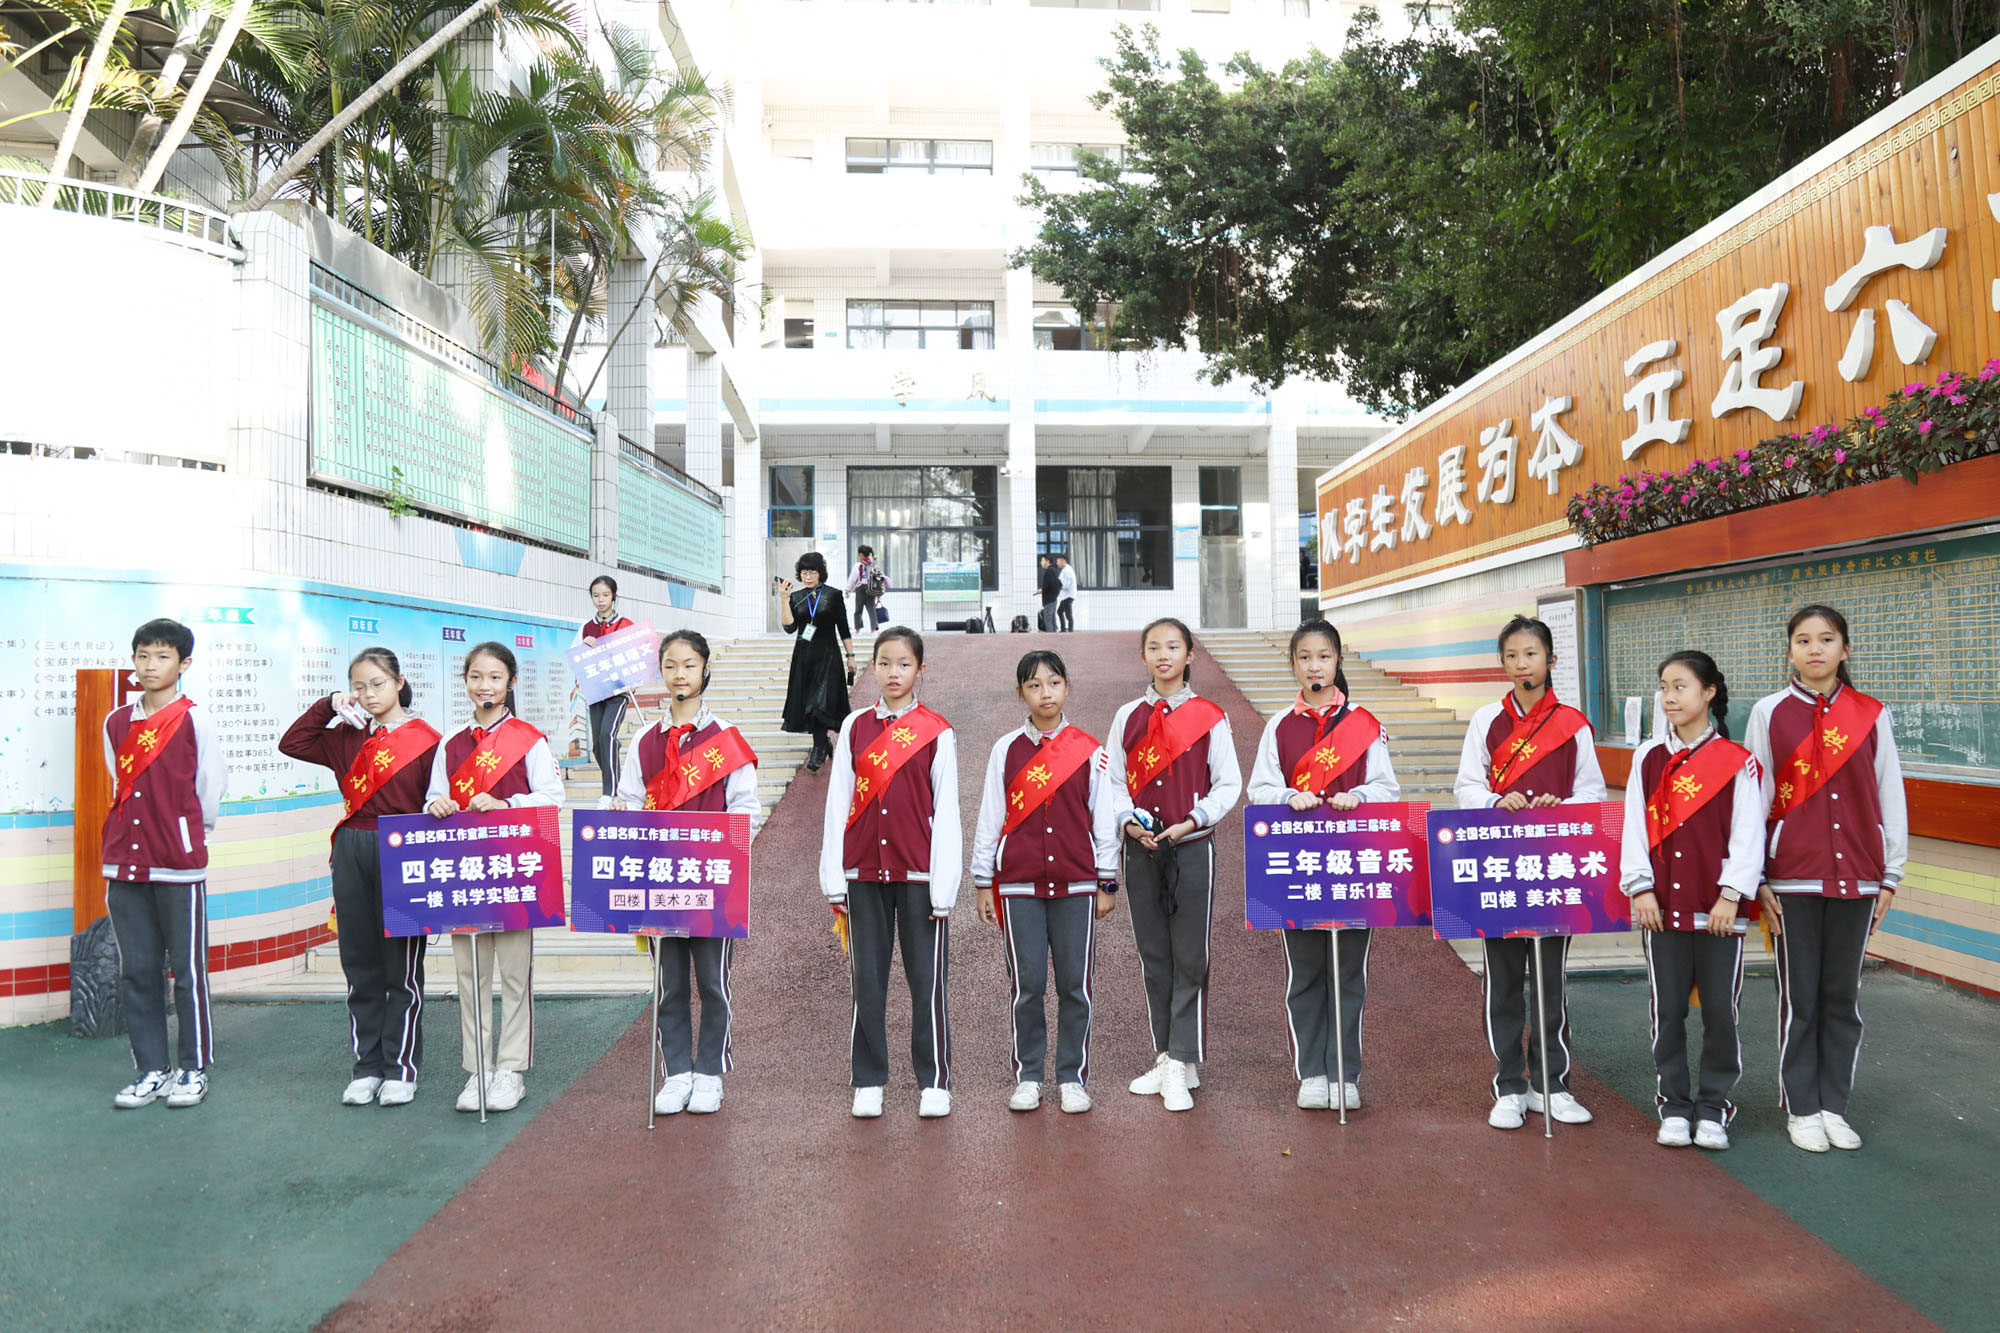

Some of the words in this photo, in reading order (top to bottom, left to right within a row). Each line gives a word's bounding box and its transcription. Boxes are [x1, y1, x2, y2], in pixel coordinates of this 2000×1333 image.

[1321, 395, 1584, 565] 以学生发展为本
[1621, 193, 2000, 460] 立足六
[352, 620, 374, 632] 四年级
[444, 628, 462, 640] 五年级
[584, 642, 654, 678] 五年级语文
[222, 748, 273, 758] 语故事365》
[404, 824, 532, 845] 全国名师工作室第三届年会
[597, 826, 724, 843] 全国名师工作室第三届年会
[1271, 819, 1401, 835] 全国名师工作室第三届年会
[1455, 821, 1594, 841] 全国名师工作室第三届年会
[401, 851, 544, 884] 四年级科学
[592, 855, 732, 885] 四年级英语
[1265, 848, 1414, 876] 三年级音乐
[1452, 850, 1608, 883] 四年级美术
[410, 891, 444, 908] 一楼
[452, 885, 537, 906] 科学实验室
[613, 894, 641, 907] 四楼
[1287, 883, 1322, 900] 二楼
[1331, 881, 1393, 900] 音乐1室
[1480, 890, 1517, 909] 四楼
[1526, 887, 1583, 907] 美术室
